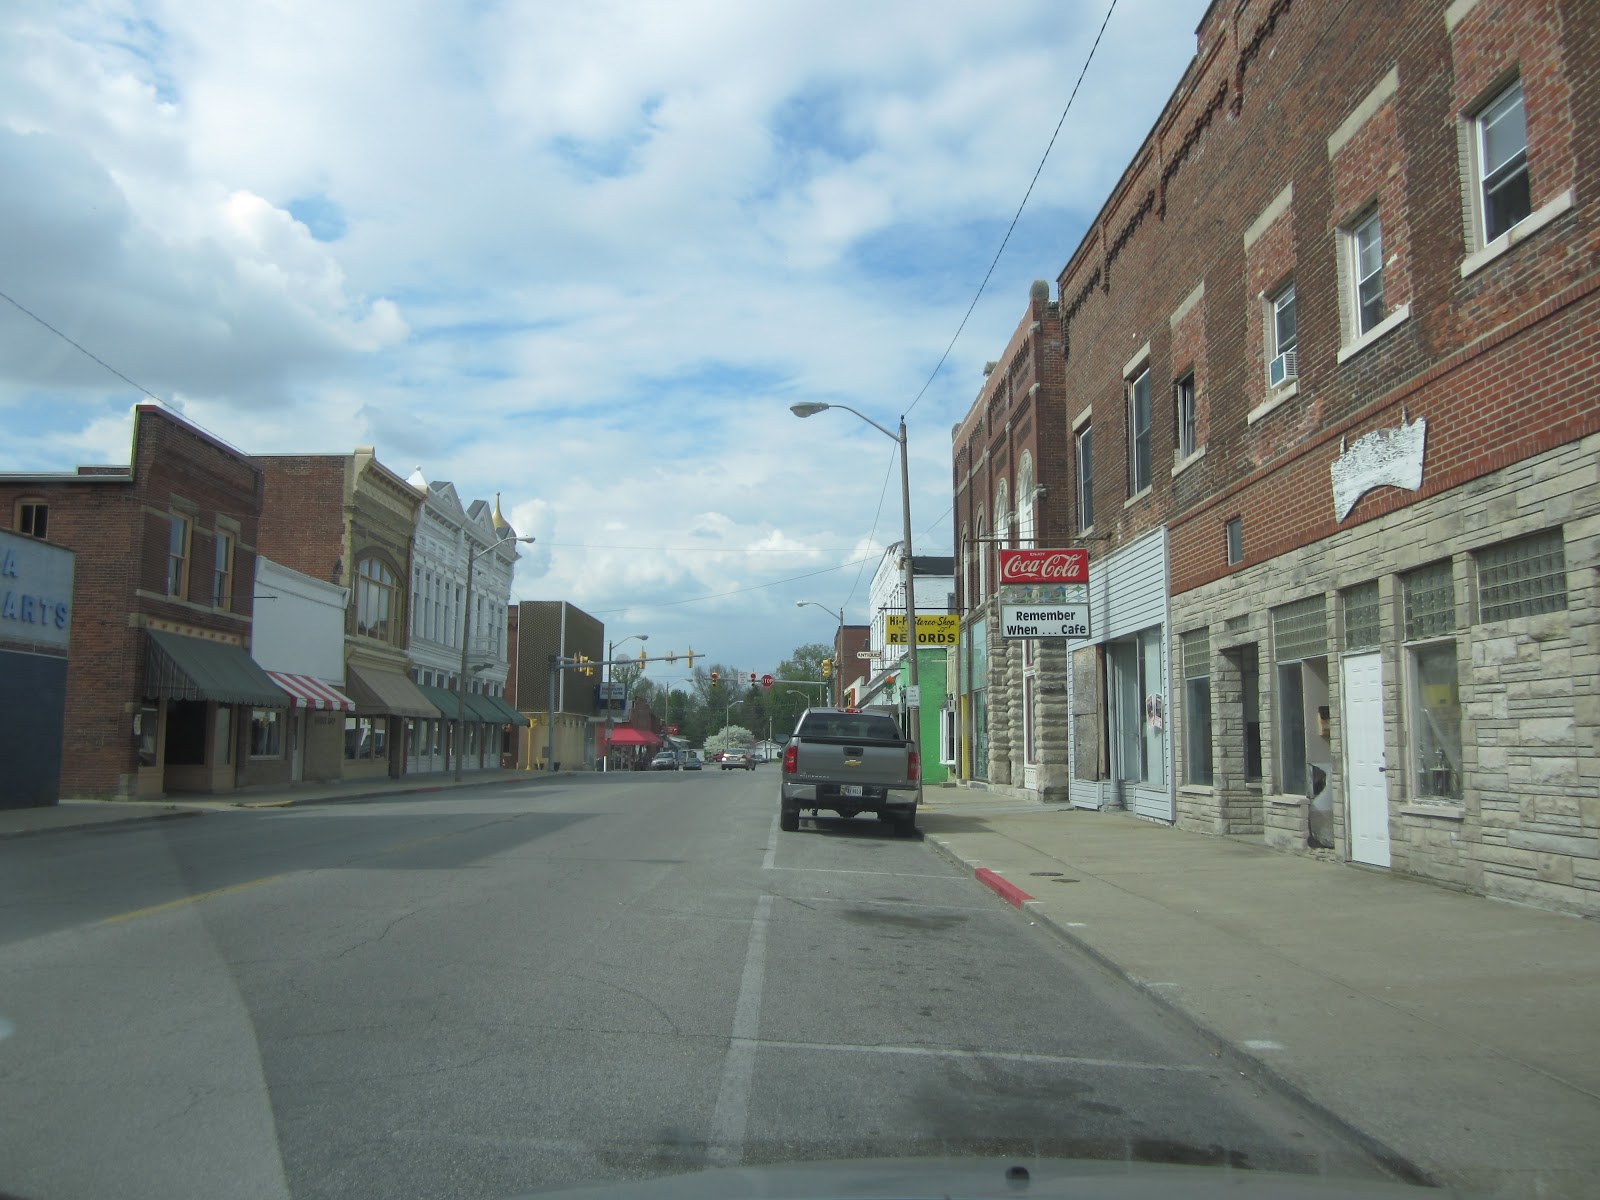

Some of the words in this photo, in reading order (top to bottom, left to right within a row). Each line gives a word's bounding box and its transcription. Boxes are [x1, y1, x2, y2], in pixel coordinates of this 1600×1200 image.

[1004, 554, 1082, 578] Coca-Cola
[1016, 611, 1076, 621] Remember
[937, 616, 955, 628] Shop
[1006, 625, 1038, 635] When
[1061, 624, 1087, 635] Cafe
[890, 633, 956, 642] REORDS
